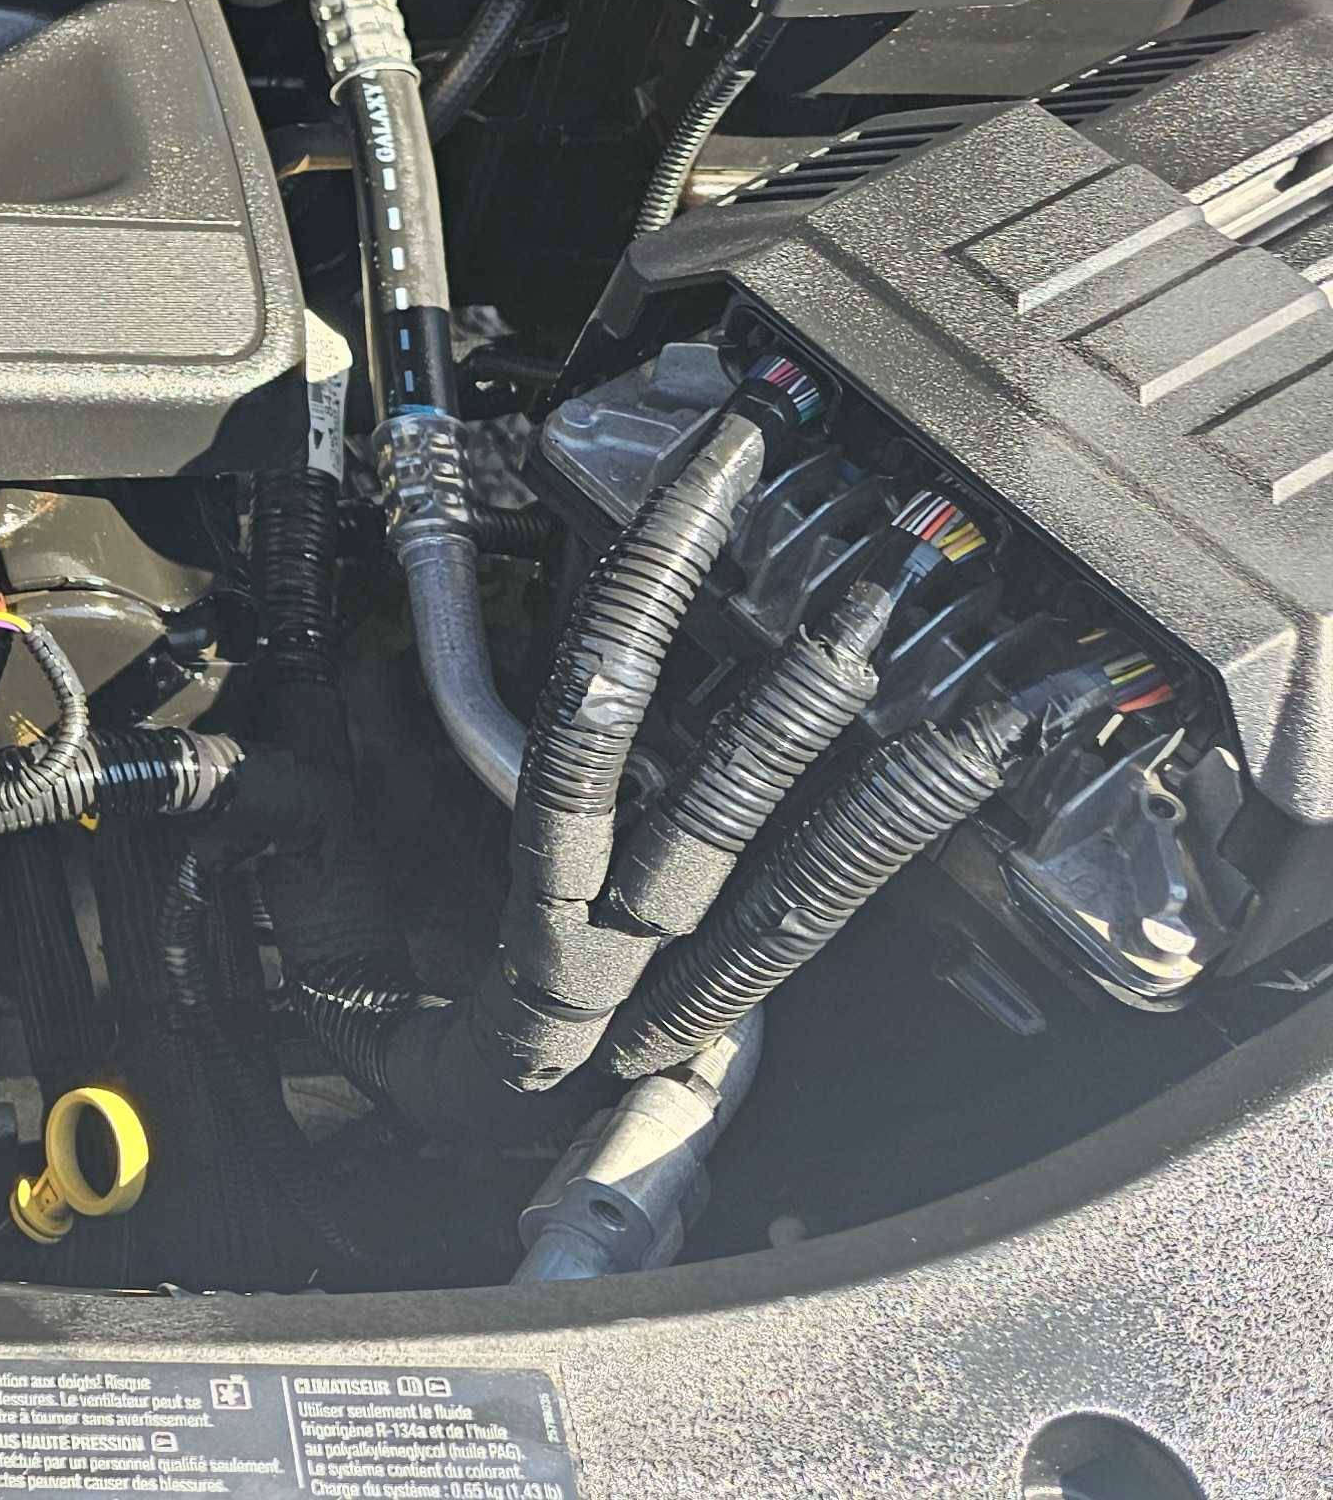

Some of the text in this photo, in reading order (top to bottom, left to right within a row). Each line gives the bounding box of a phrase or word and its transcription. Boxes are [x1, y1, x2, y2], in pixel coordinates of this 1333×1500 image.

[362, 83, 396, 163] GALAXY
[30, 1375, 56, 1389] aux
[104, 1373, 152, 1393] Risque
[293, 1377, 391, 1396] CLIMATISEUR
[60, 1390, 79, 1407] Le
[79, 1392, 152, 1409] ventilateur
[152, 1393, 183, 1412] peut
[183, 1396, 202, 1410] se
[297, 1400, 473, 1420] Utiliser seulement le fluide
[31, 1409, 80, 1426] tourner
[81, 1413, 116, 1426] sans
[375, 1421, 428, 1439] R-134a
[428, 1423, 445, 1439] et
[445, 1423, 464, 1439] de
[21, 1433, 72, 1450] HAUTE
[71, 1434, 145, 1452] PRESSION
[304, 1442, 323, 1456] au
[448, 1442, 488, 1460] (huile
[44, 1456, 68, 1472] par
[68, 1456, 89, 1470] un
[89, 1455, 156, 1473] personnel
[157, 1455, 209, 1475] qualifié
[307, 1459, 326, 1476] Le
[387, 1461, 444, 1478] contient
[444, 1462, 462, 1478] du
[27, 1473, 83, 1491] peuvent
[83, 1476, 129, 1491] causer
[131, 1474, 159, 1491] des
[310, 1478, 360, 1500] Charge
[362, 1479, 383, 1497] du
[484, 1481, 503, 1500] kg
